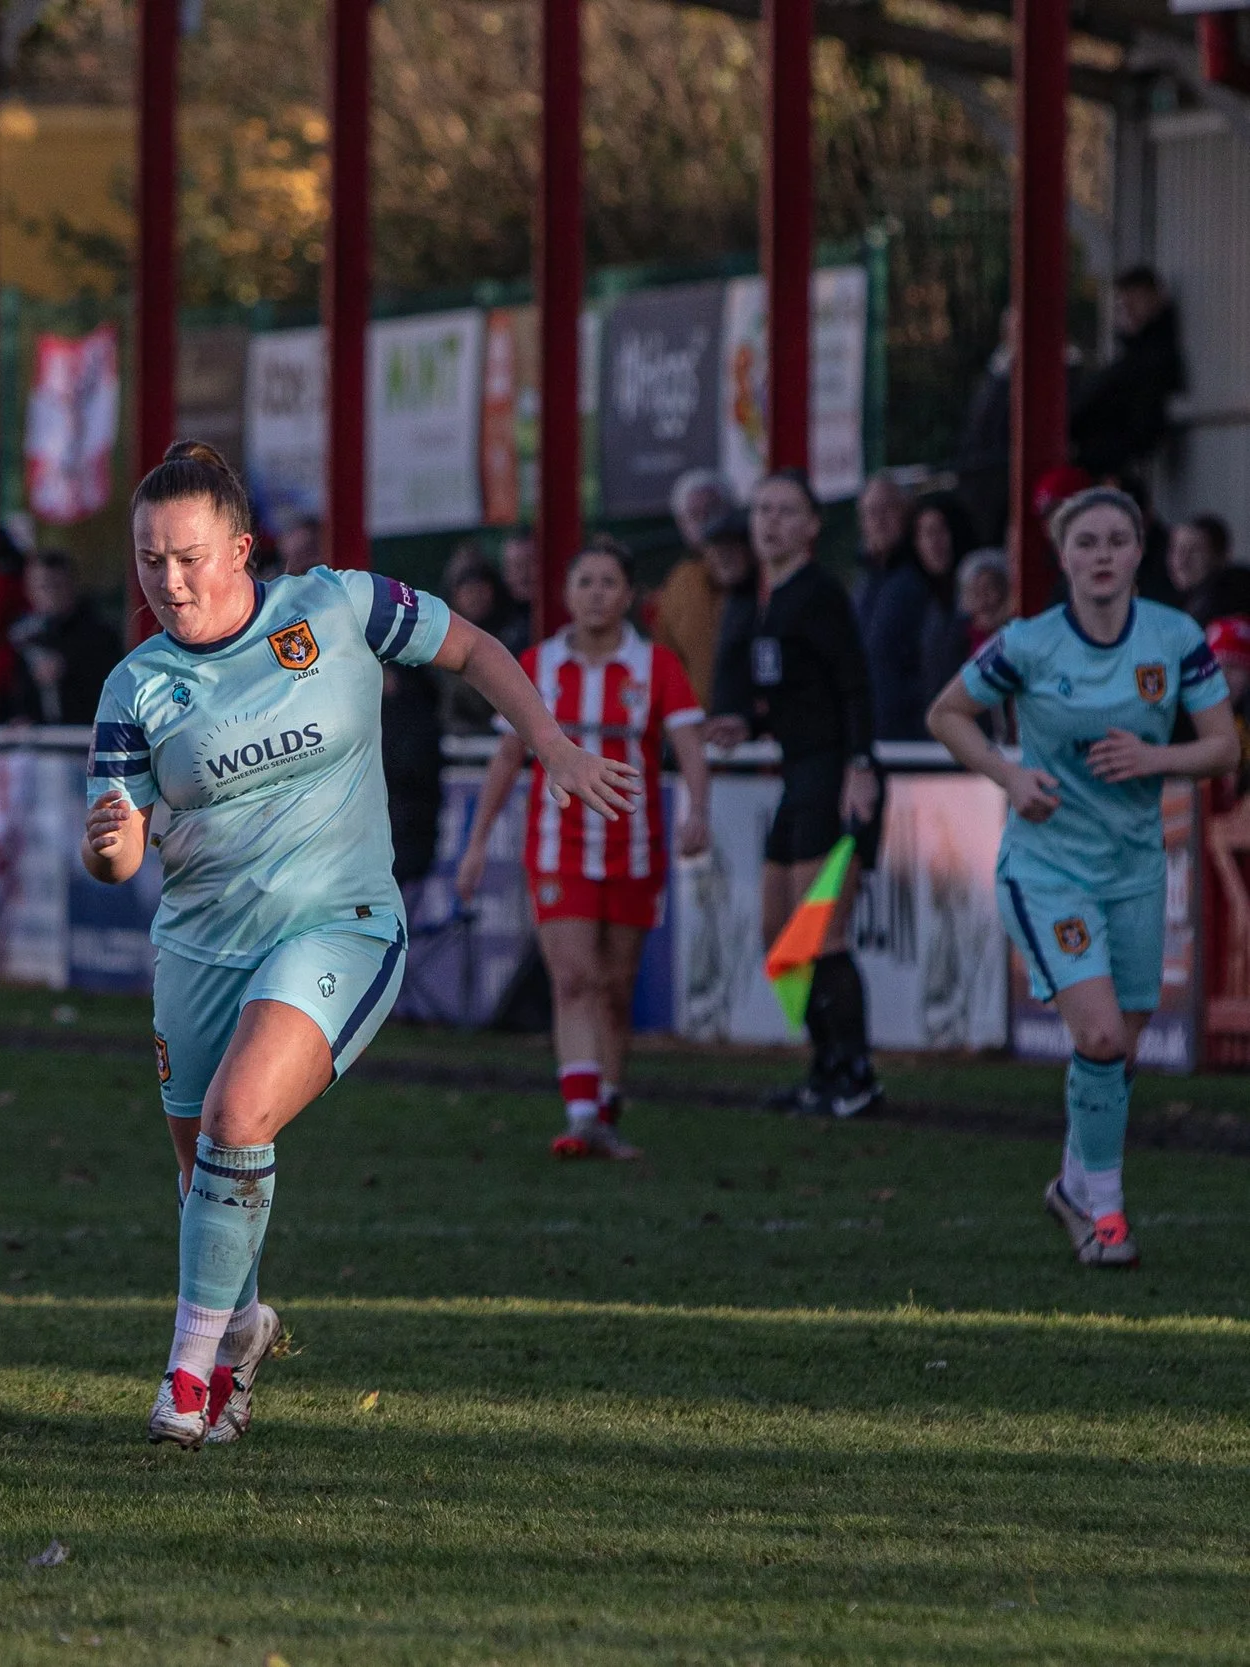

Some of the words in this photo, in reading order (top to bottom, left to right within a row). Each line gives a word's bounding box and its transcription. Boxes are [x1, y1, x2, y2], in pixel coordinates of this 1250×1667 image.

[293, 667, 319, 682] LADIES
[206, 722, 323, 779] WOLDS
[215, 765, 270, 788] ENGINEERING
[270, 752, 308, 768] SERVICES
